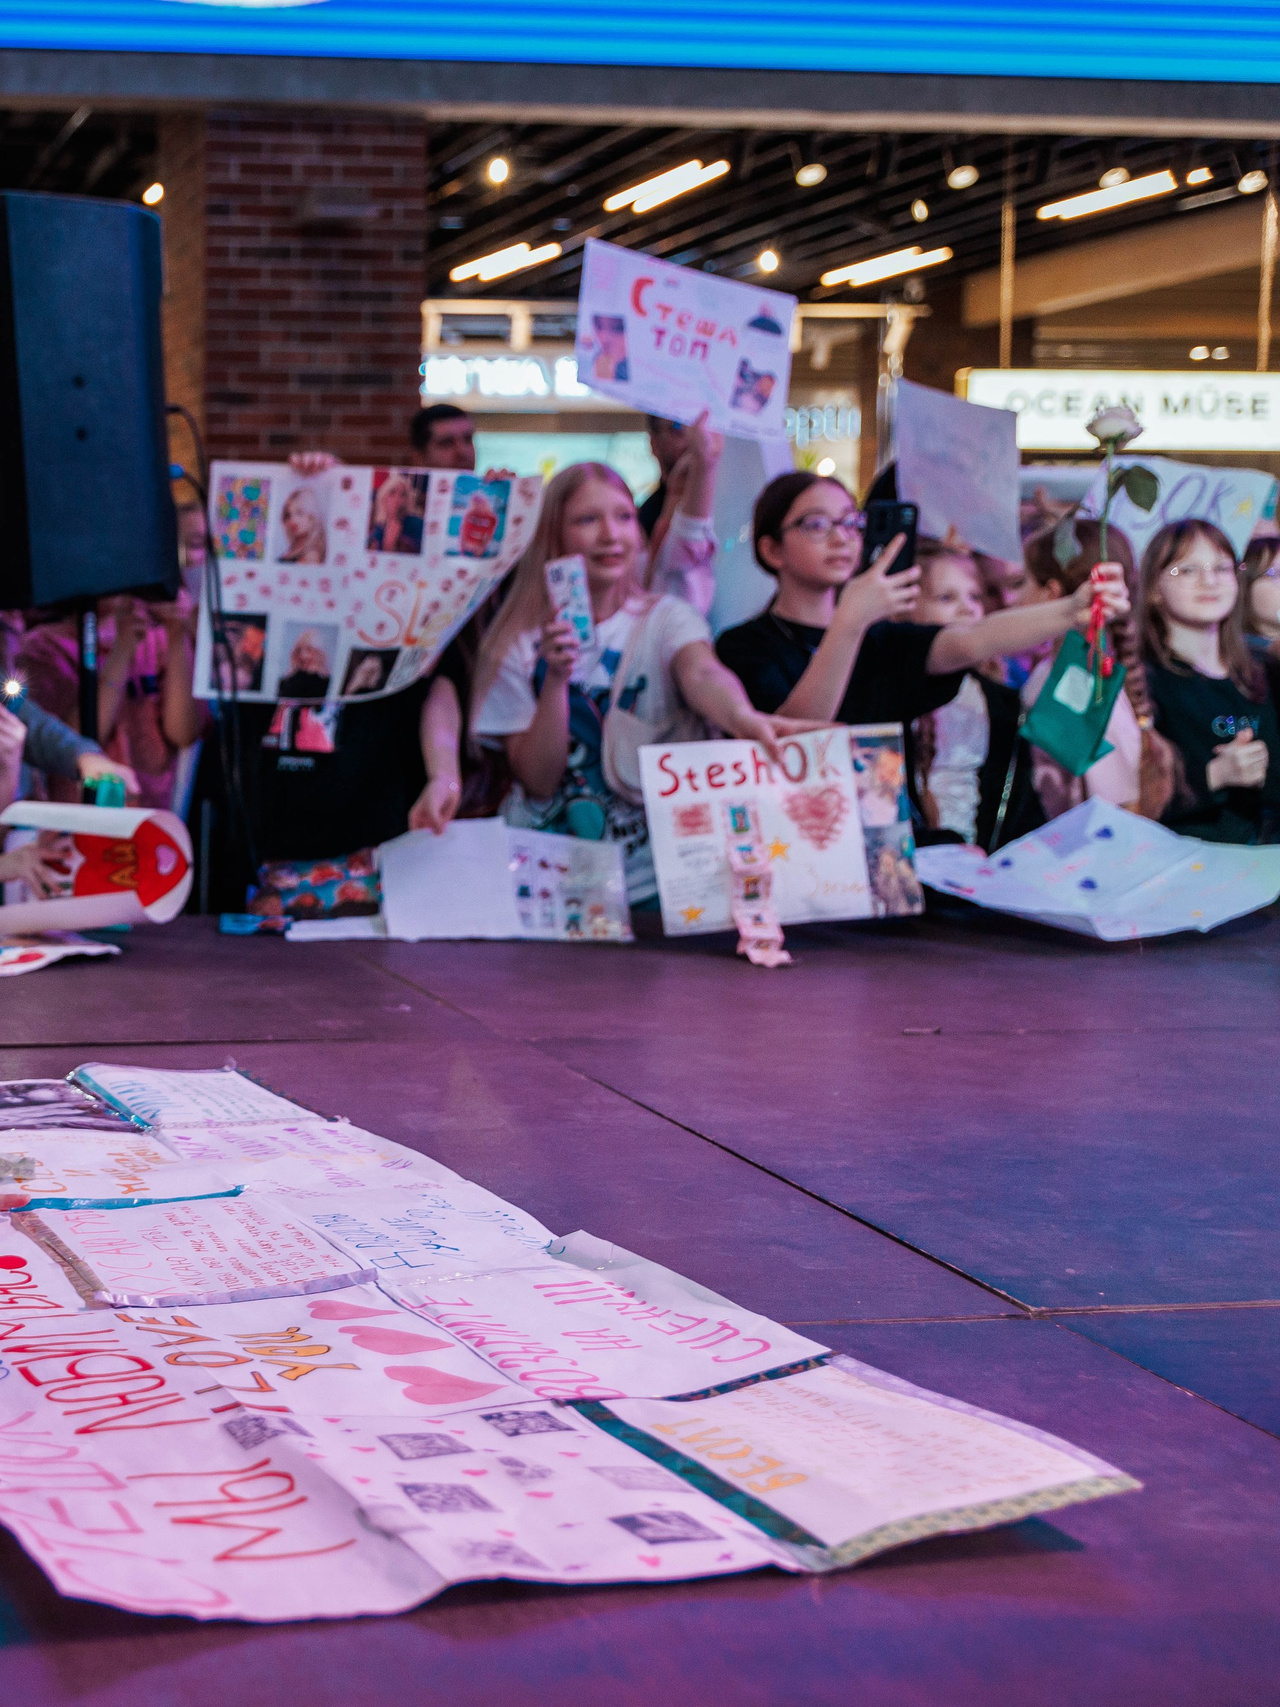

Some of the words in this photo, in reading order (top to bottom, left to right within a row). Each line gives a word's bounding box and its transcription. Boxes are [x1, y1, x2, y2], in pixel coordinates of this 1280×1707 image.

[1004, 387, 1144, 418] OCEAN
[116, 1303, 275, 1397] LOVE
[401, 1297, 624, 1400] ВОЗЬМИТЕ
[561, 1328, 642, 1351] НА
[654, 1419, 807, 1496] БЕСИТ
[125, 1459, 355, 1564] МЫ
